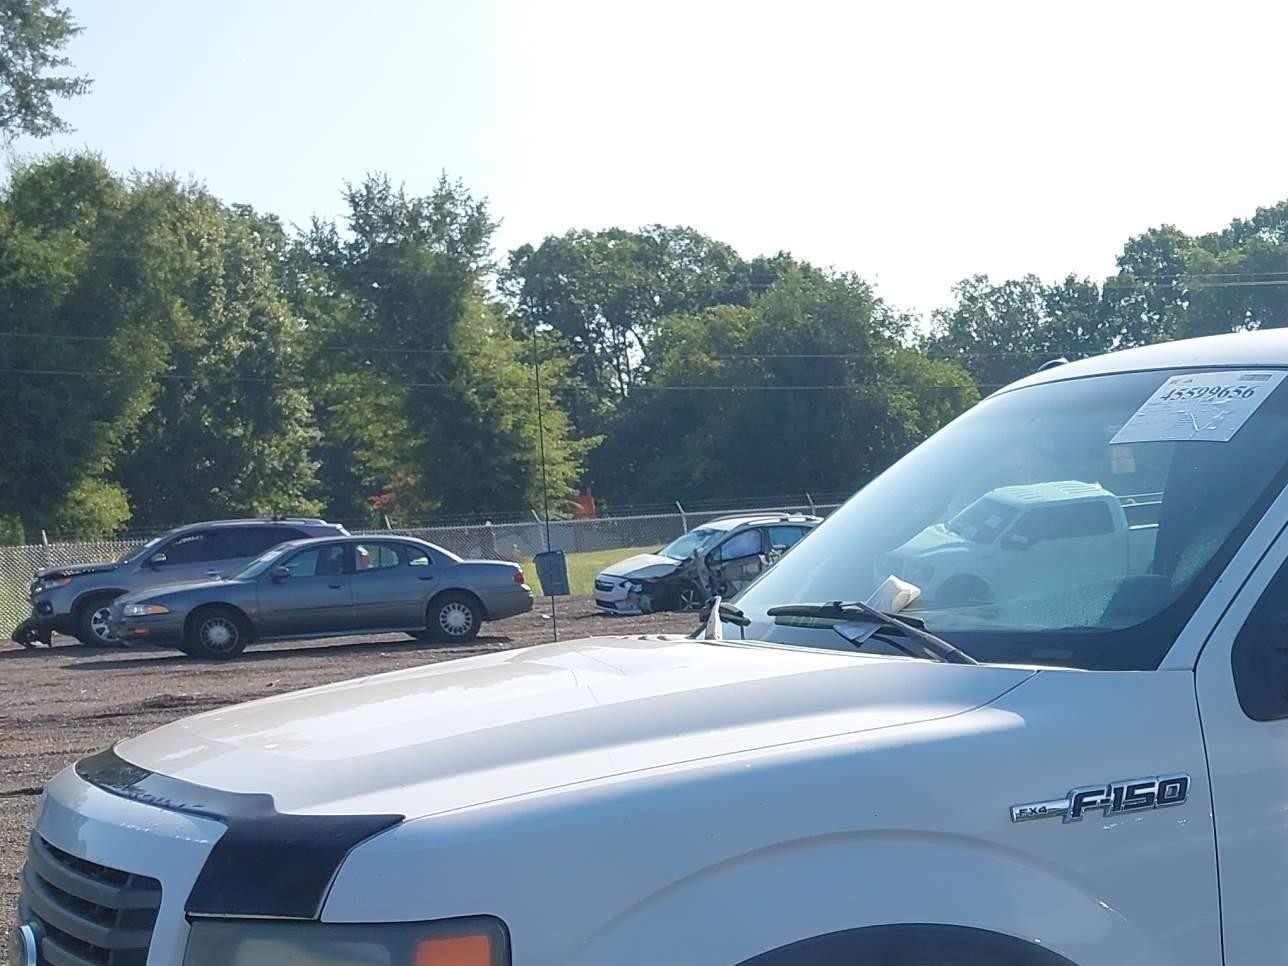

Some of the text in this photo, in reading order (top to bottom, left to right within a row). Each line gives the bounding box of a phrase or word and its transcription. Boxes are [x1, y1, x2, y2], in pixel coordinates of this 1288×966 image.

[1160, 385, 1257, 401] 45599656
[1018, 773, 1192, 824] FX4 F-150
